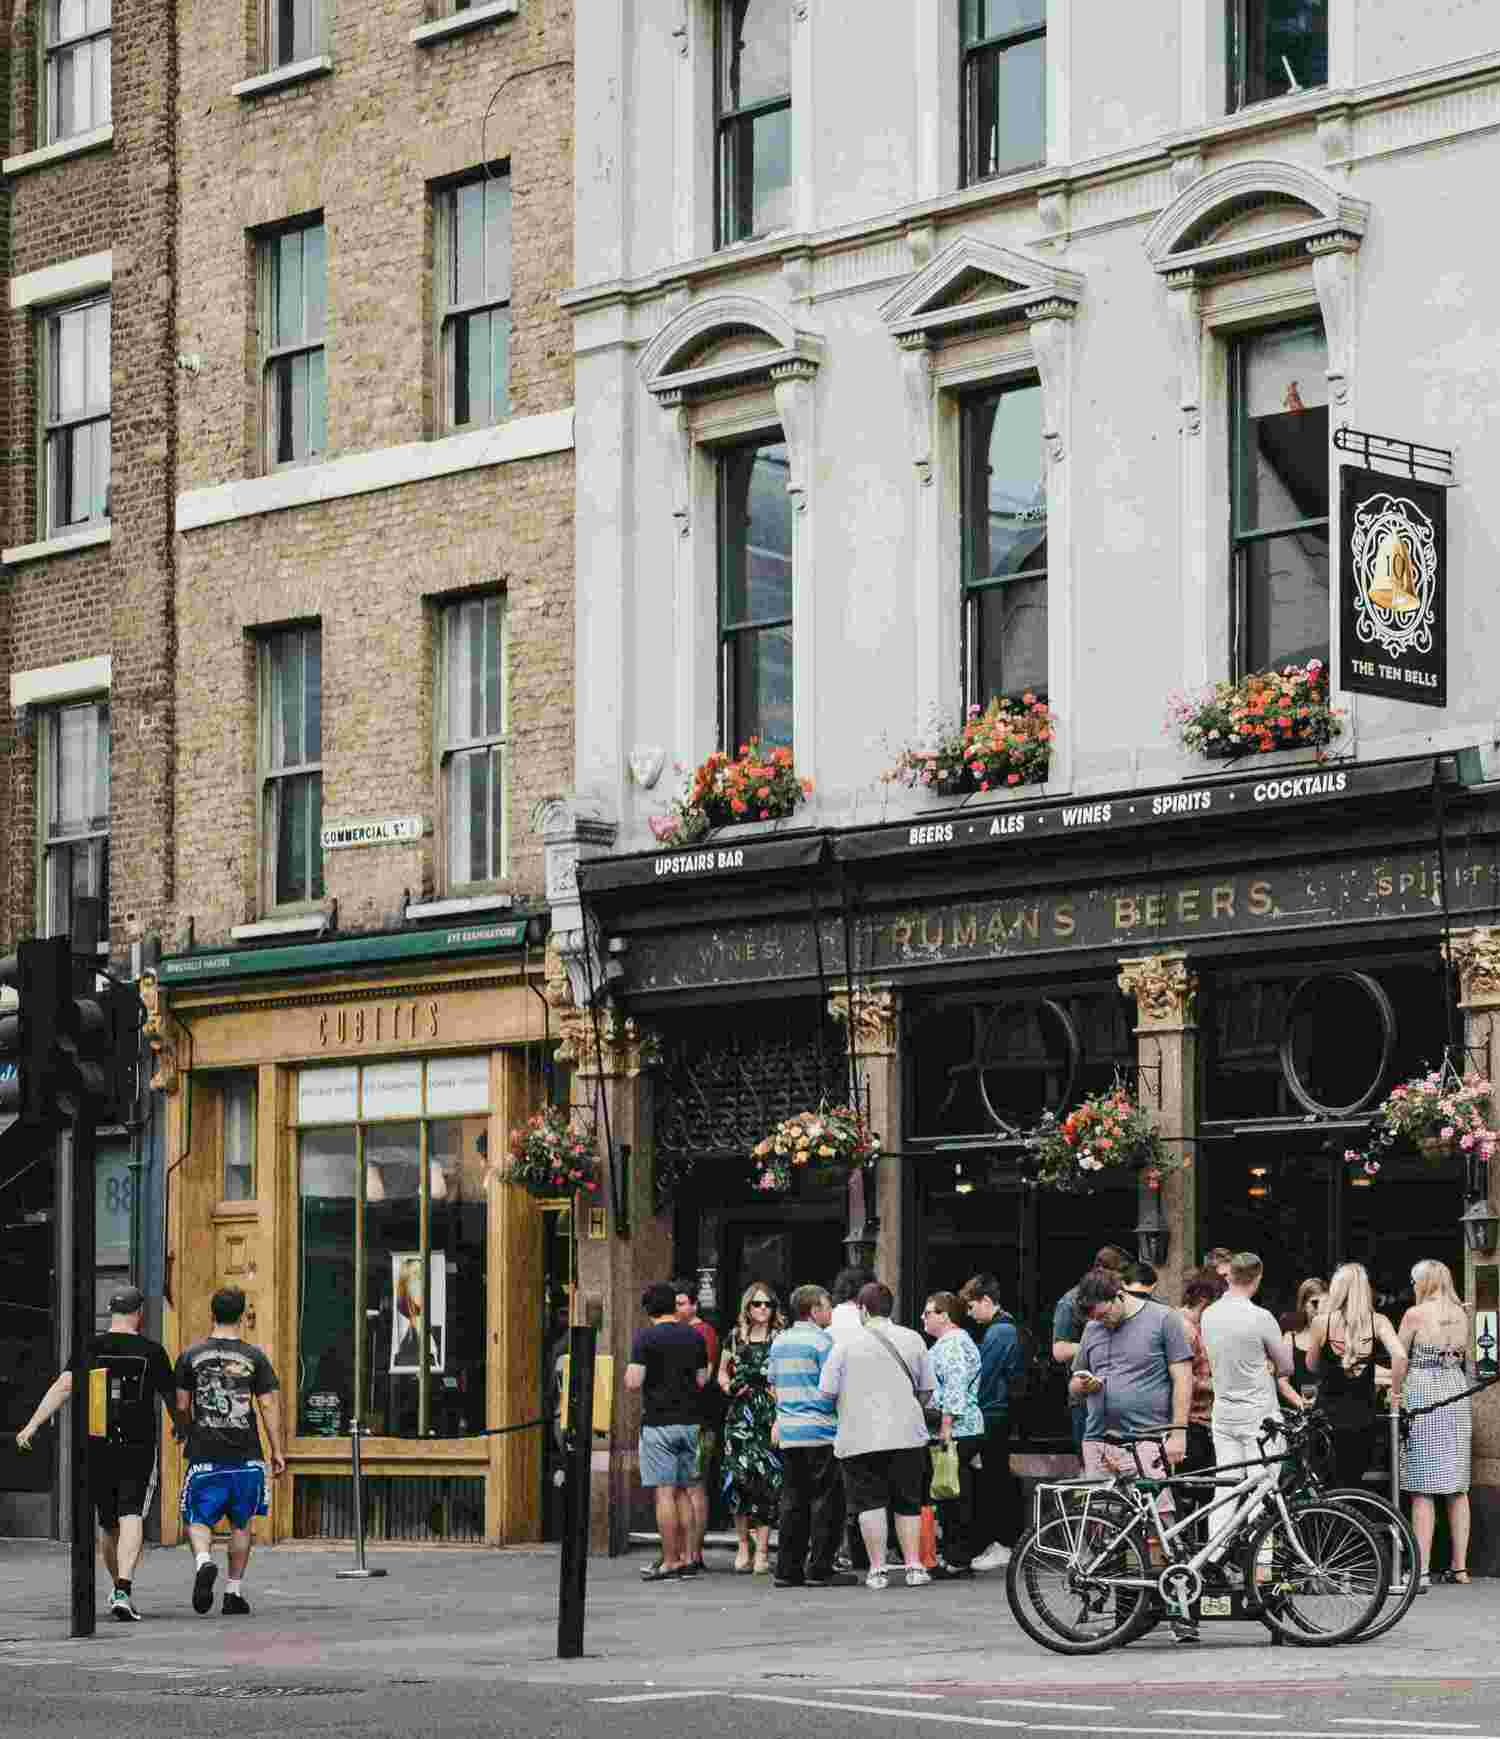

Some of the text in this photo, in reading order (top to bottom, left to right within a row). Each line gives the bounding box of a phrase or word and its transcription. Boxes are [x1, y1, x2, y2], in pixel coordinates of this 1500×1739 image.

[1351, 659, 1438, 688] THE TEN BELLS
[909, 772, 1346, 845] BEERS ALES WINES SPIRITS COCKTAILS
[323, 823, 389, 844] COMMERCIAL
[655, 849, 744, 875] UPSTAIRS BAR
[1114, 880, 1273, 930] BEERS
[319, 1001, 440, 1046] CUBITTS
